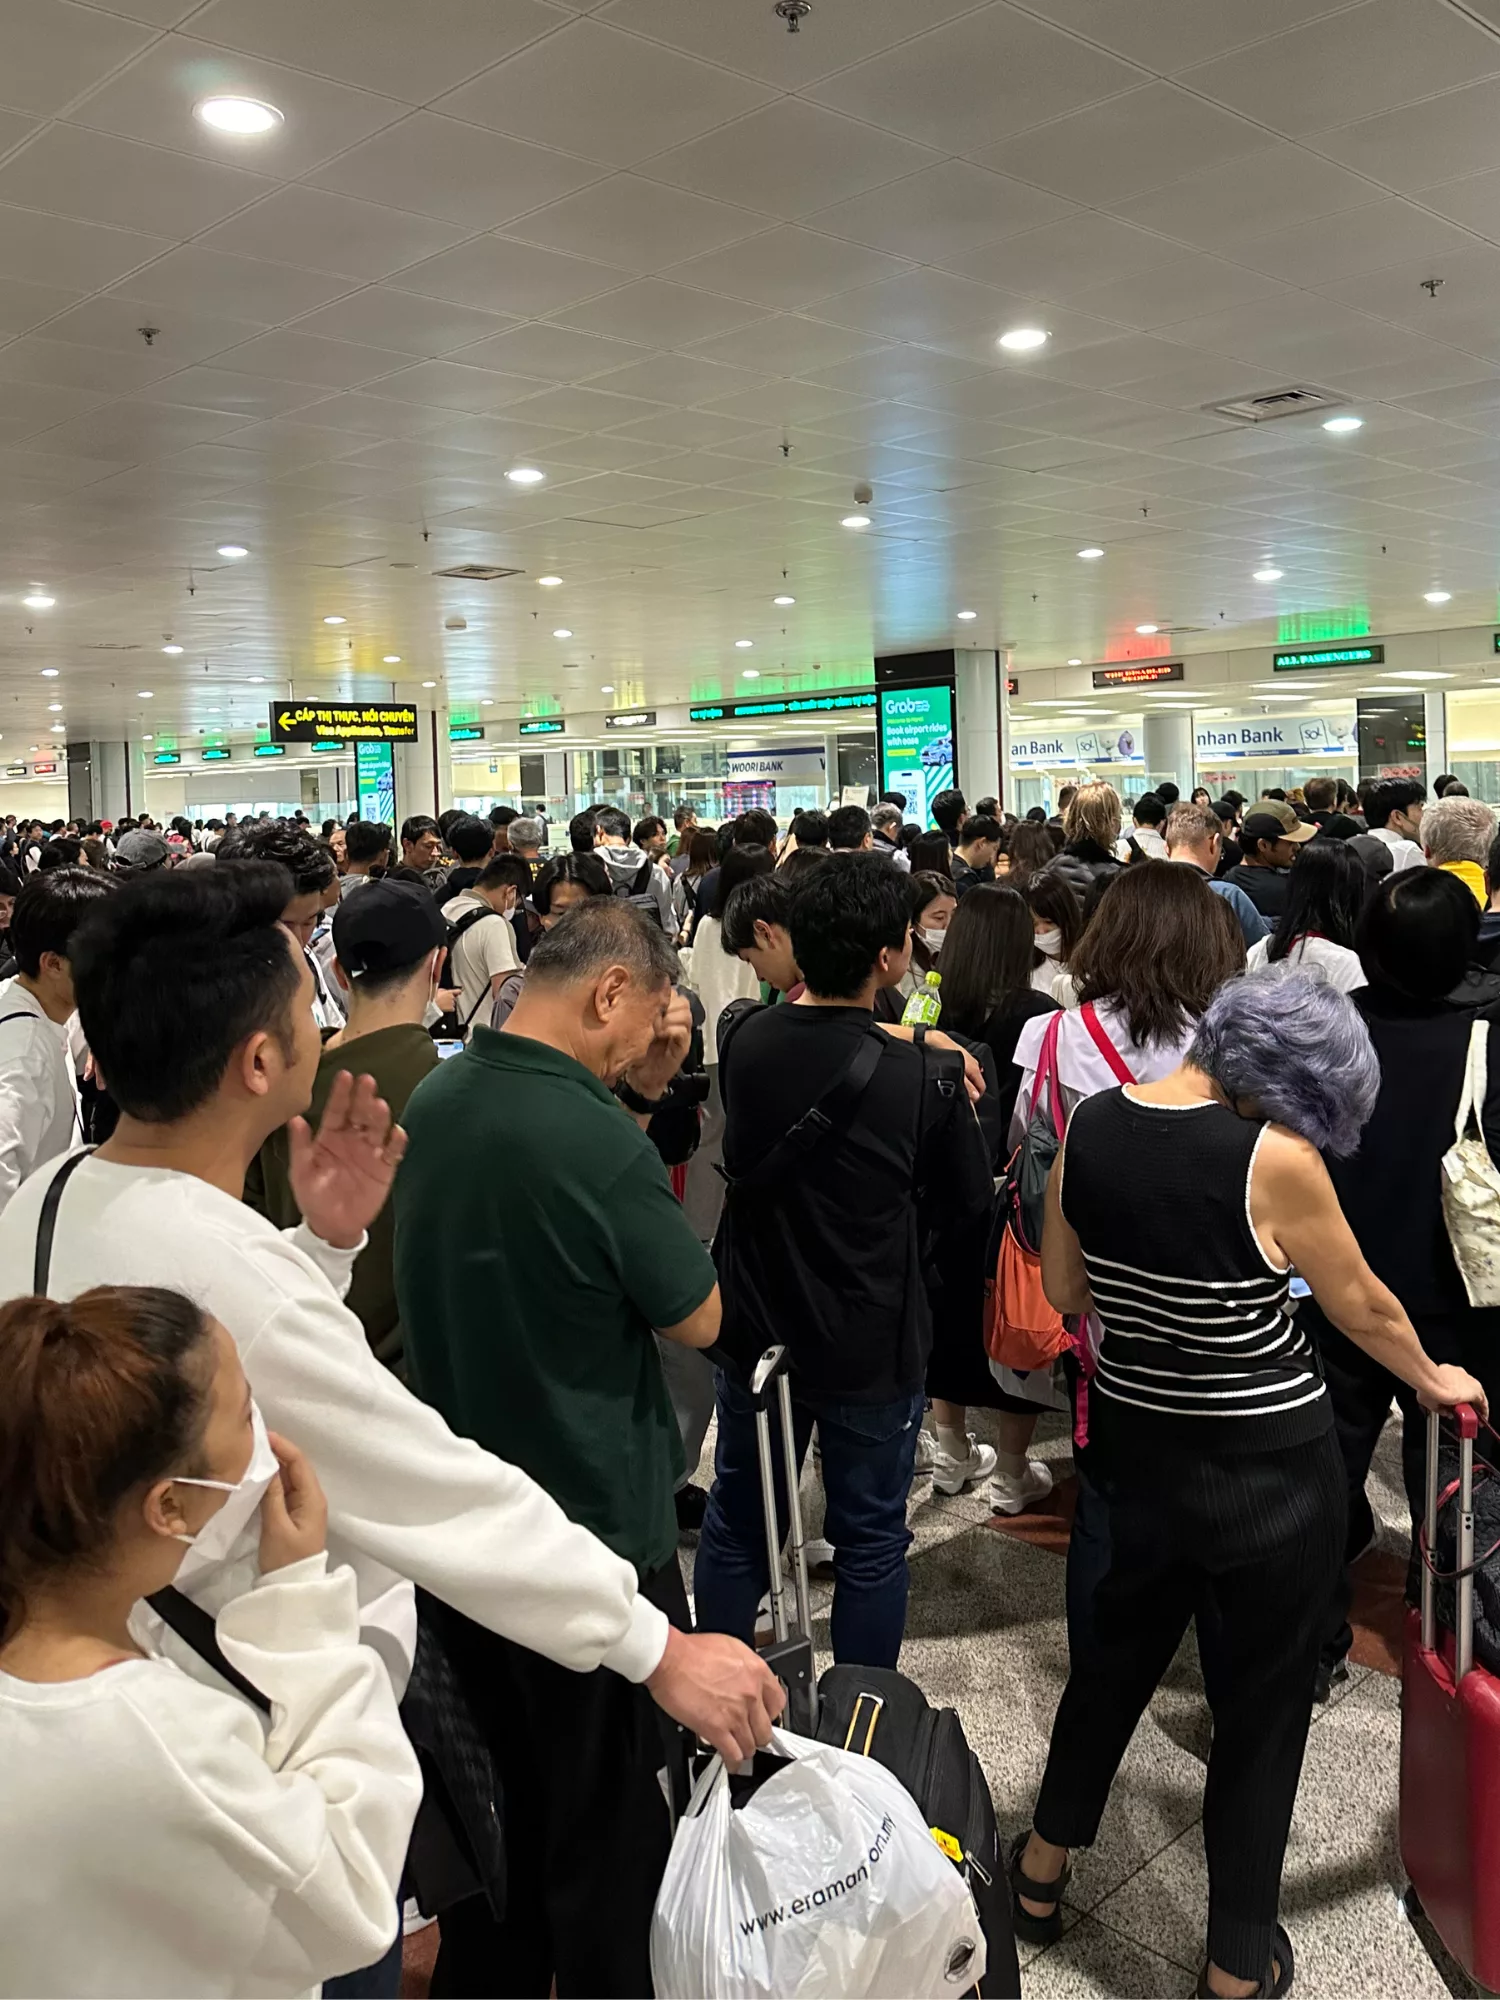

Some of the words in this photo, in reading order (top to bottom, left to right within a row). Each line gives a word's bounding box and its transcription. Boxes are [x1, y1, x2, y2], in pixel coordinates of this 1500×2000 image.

[1300, 649, 1372, 664] PASSENGERS
[885, 697, 916, 714] Grab
[886, 726, 904, 736] Book
[904, 724, 929, 736] airport
[929, 722, 948, 732] rides
[1241, 726, 1284, 744] Bank
[886, 737, 902, 747] with
[902, 737, 919, 746] ease
[1030, 739, 1064, 755] Bank
[731, 762, 759, 773] WOORI
[759, 760, 784, 772] BANK
